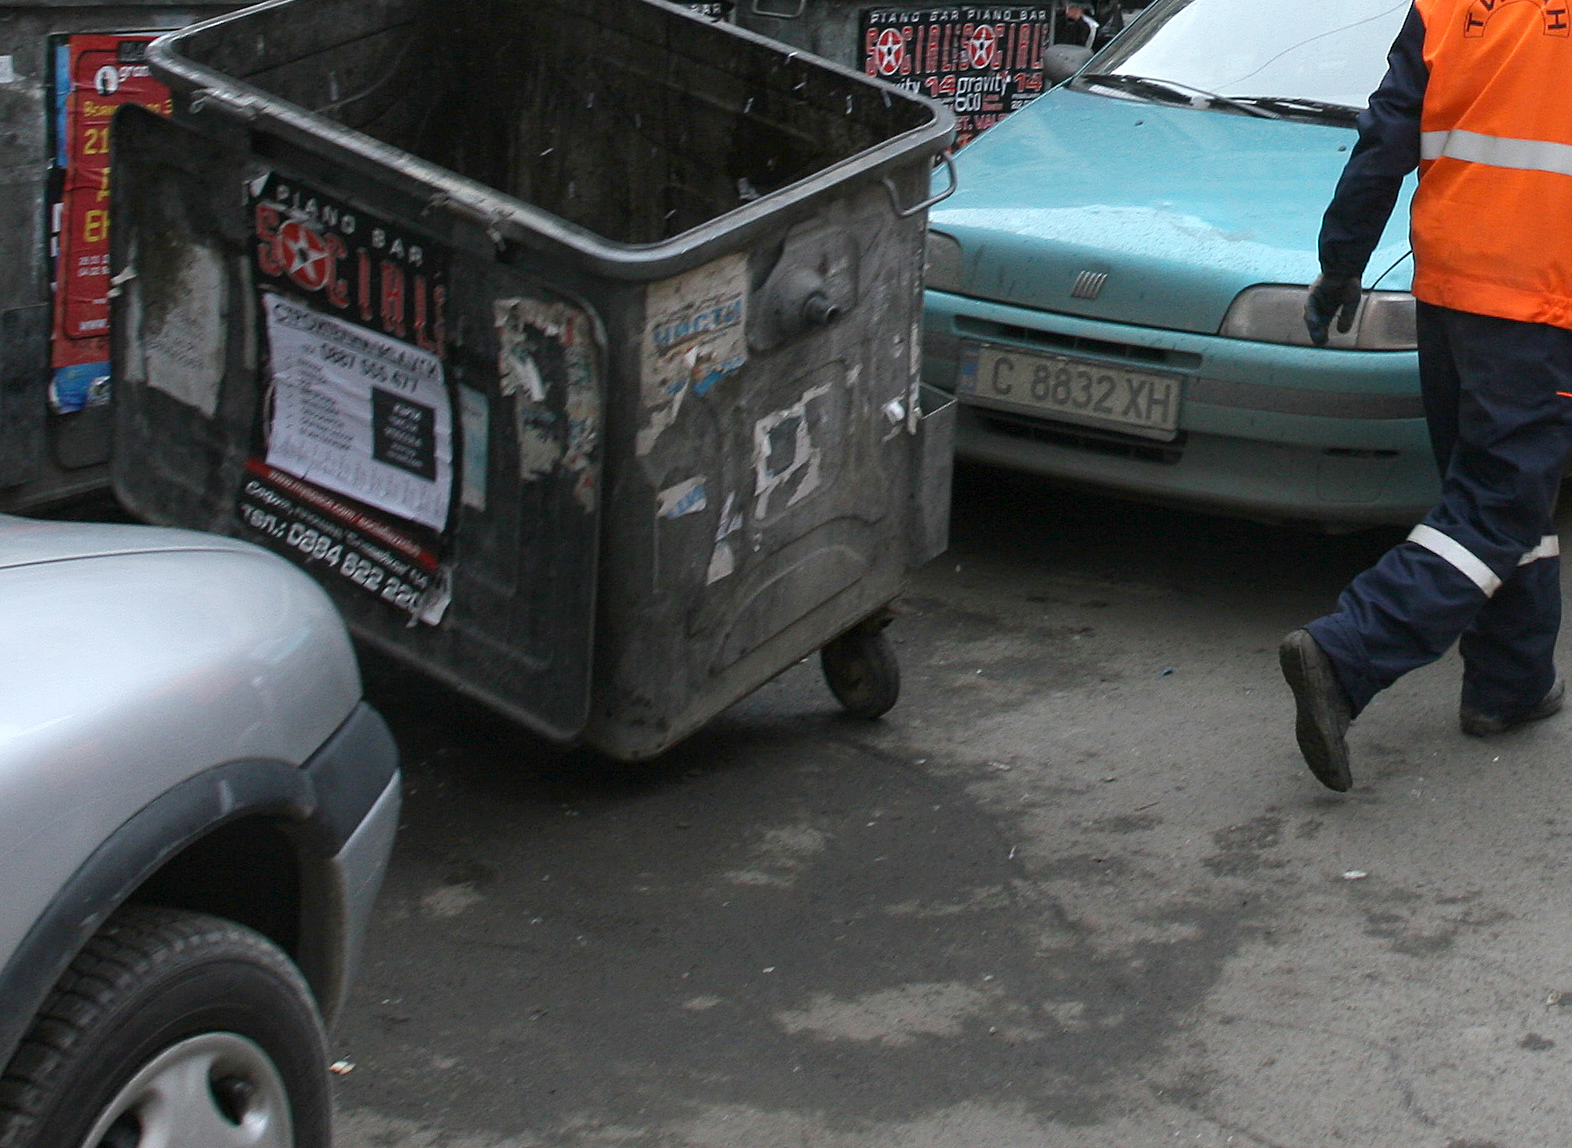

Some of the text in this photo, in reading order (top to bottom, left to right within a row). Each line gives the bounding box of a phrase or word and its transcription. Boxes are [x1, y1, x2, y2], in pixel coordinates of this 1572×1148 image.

[869, 10, 959, 24] PIANO BAR
[967, 9, 1047, 22] PIANO BAR
[925, 75, 956, 98] 14
[957, 71, 1044, 97] gravity 14
[276, 184, 424, 267] PIANO BAR
[992, 356, 1172, 425] C 8832 XH
